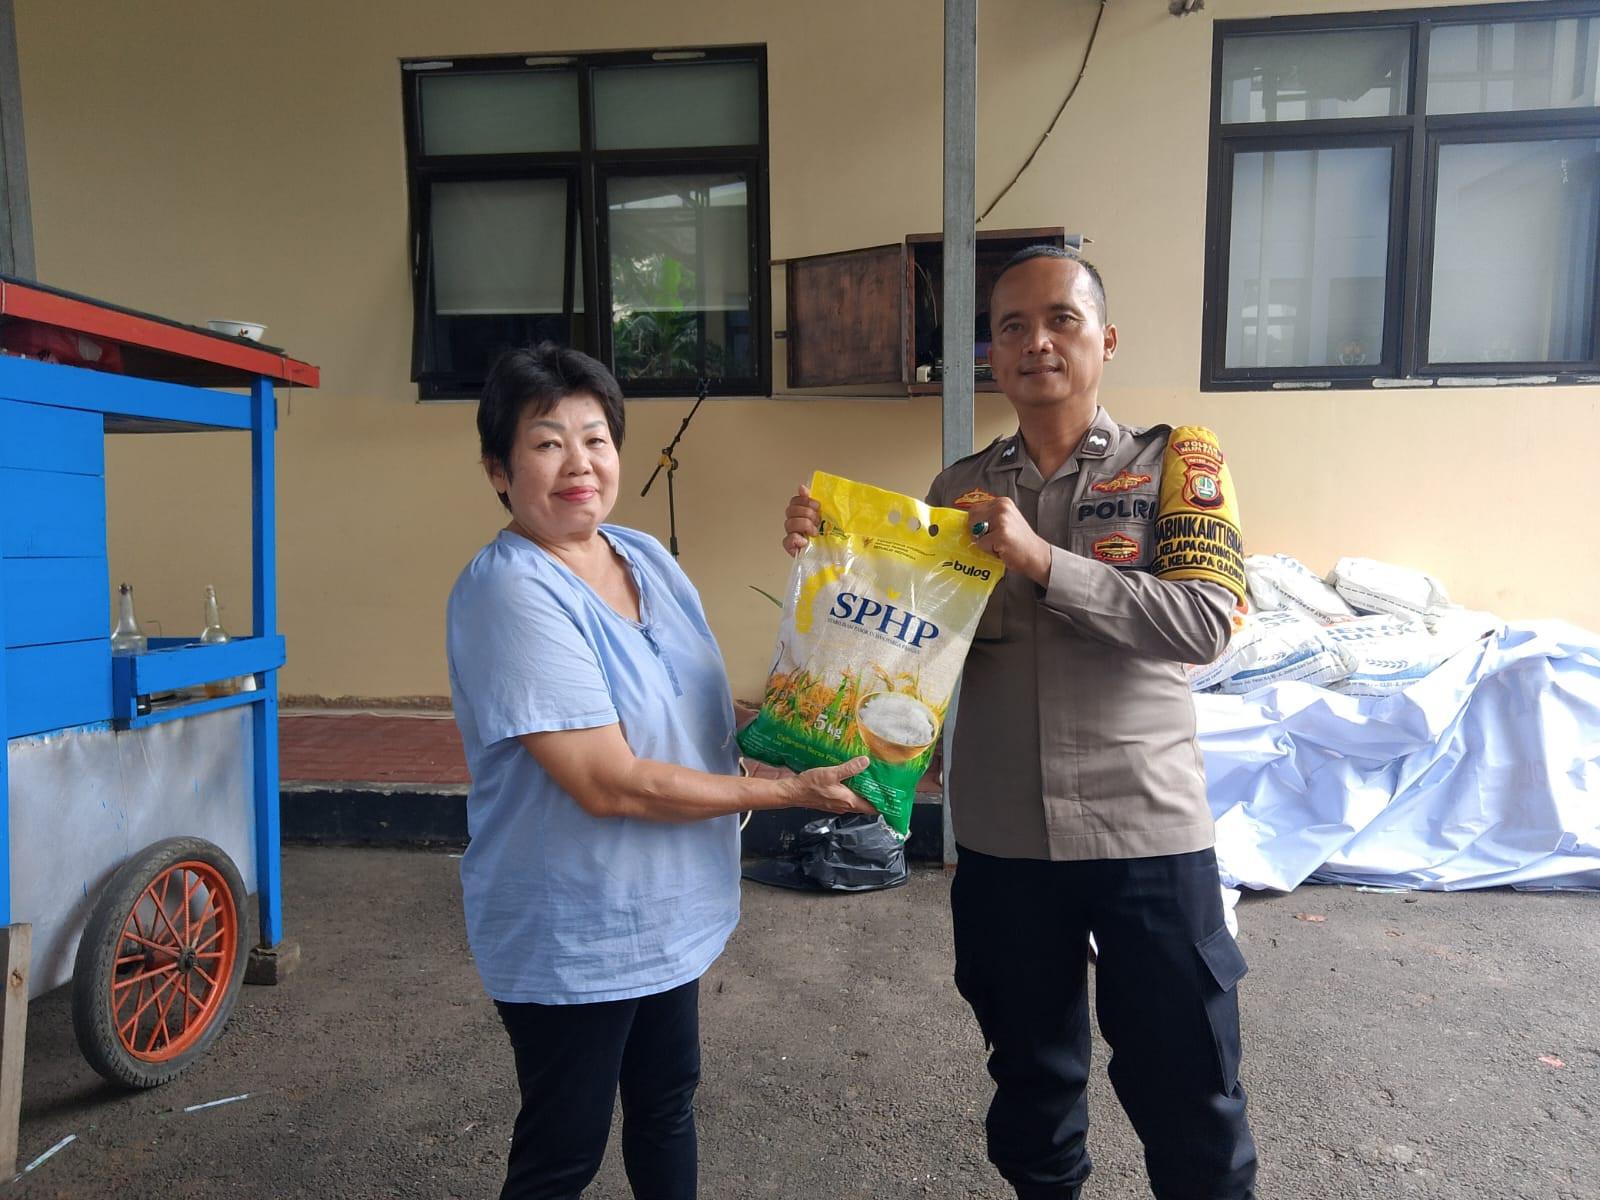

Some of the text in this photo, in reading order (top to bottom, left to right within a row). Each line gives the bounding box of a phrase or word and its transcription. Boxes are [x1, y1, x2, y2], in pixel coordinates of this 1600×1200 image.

[1078, 498, 1156, 521] POLRI
[1160, 540, 1196, 556] KELAPA
[1197, 542, 1231, 562] GADING
[1168, 554, 1214, 568] KELAPA
[952, 560, 991, 581] bulog
[829, 592, 940, 649] SPHP
[814, 713, 843, 740] 5 kg
